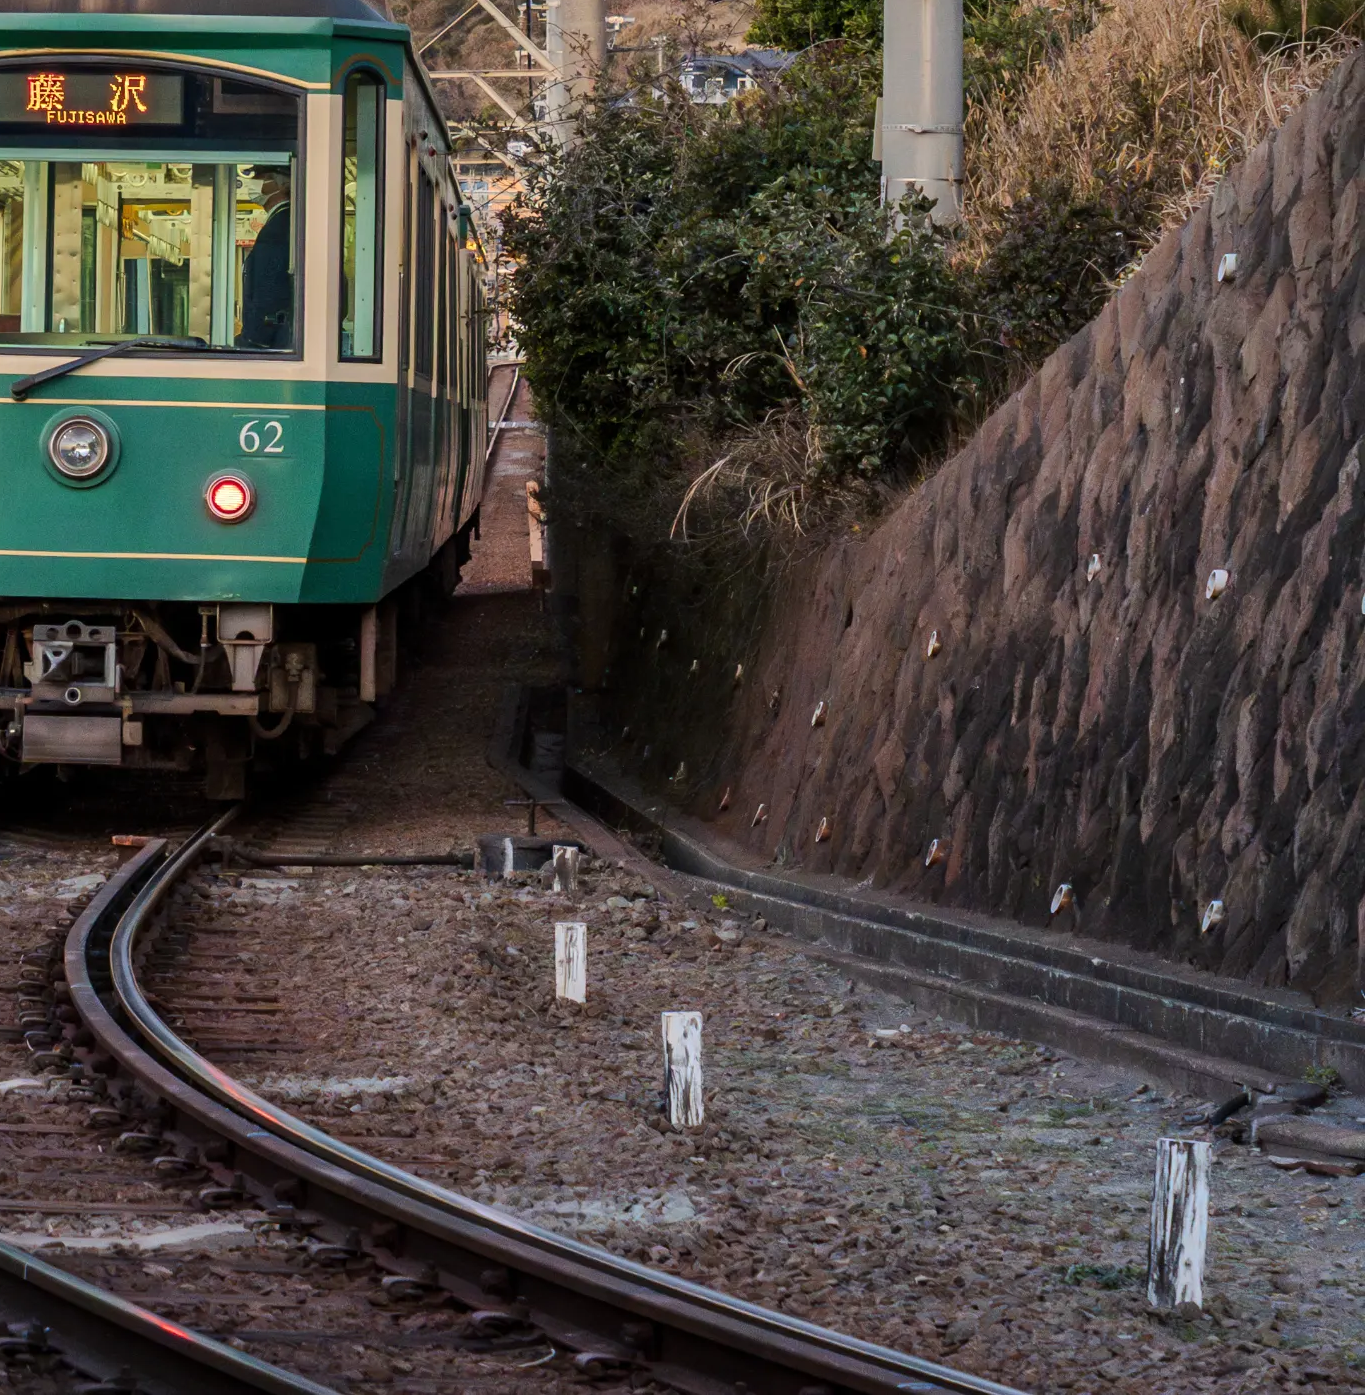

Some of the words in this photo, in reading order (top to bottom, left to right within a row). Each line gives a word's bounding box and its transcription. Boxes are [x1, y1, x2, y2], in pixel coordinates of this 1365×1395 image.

[27, 74, 147, 112] 藤沢
[47, 110, 127, 124] FUJISAWA
[239, 420, 284, 453] 62
